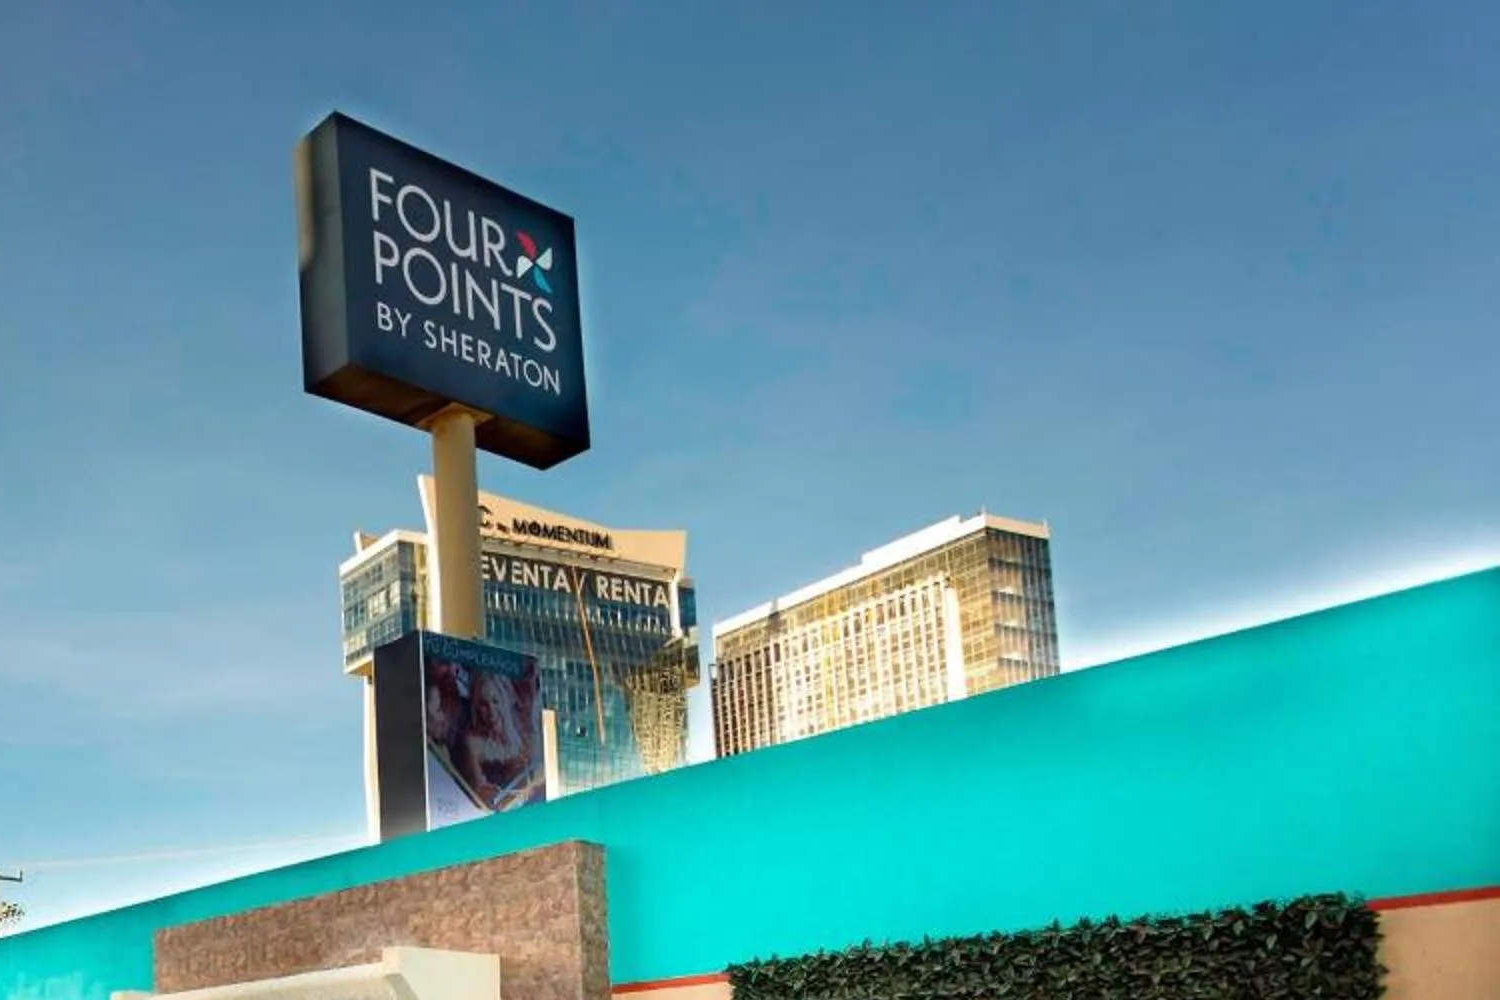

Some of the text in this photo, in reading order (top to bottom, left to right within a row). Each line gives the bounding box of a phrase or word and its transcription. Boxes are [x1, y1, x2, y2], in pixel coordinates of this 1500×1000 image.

[369, 167, 512, 277] FOUR
[373, 231, 557, 351] POINTS
[377, 302, 560, 395] BY SHERATON
[512, 517, 612, 550] MOMENTUM
[596, 575, 670, 609] RENTA
